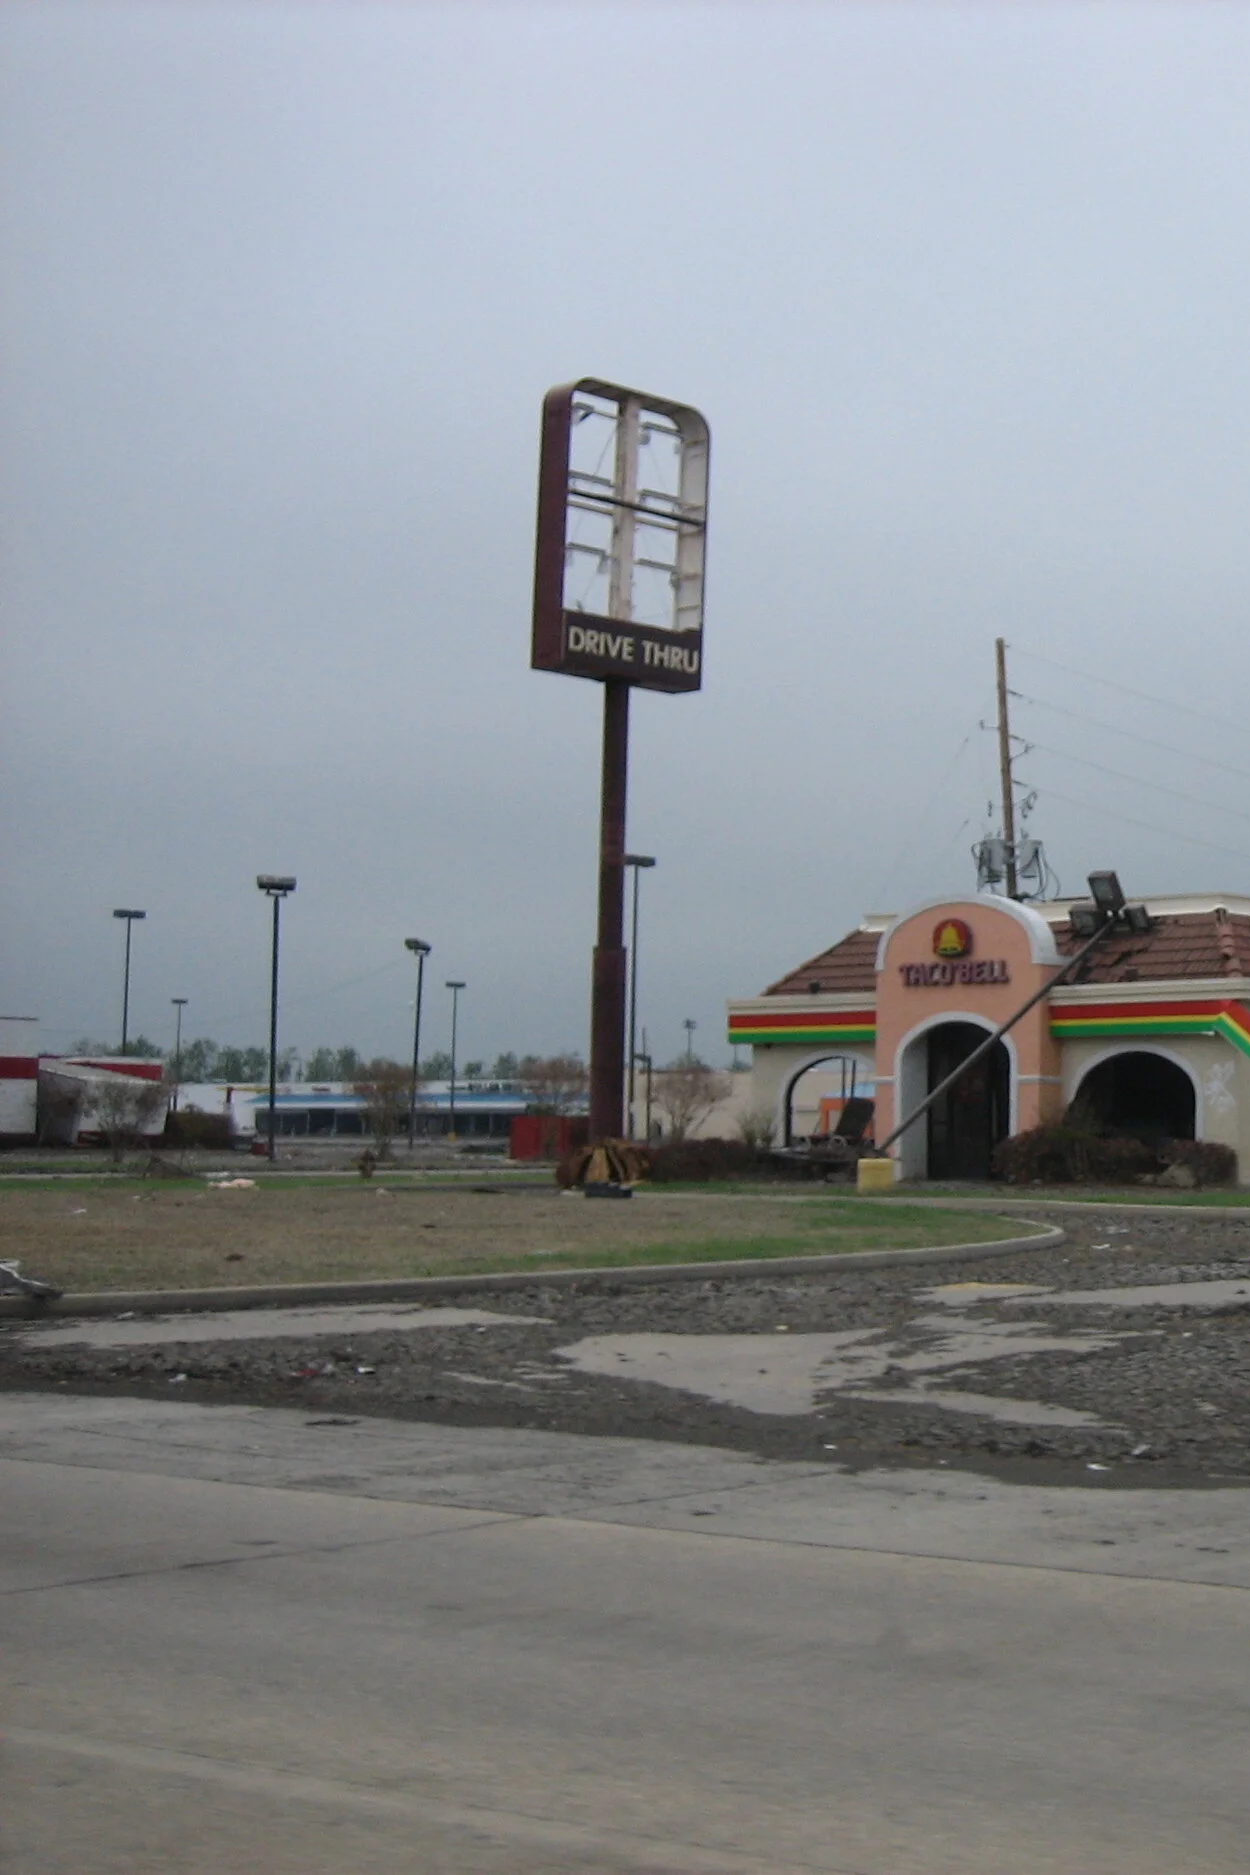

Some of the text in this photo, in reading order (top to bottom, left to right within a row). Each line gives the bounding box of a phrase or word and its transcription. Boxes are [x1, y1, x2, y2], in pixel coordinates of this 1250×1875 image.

[568, 626, 699, 674] DRIVE THRU
[899, 960, 1010, 987] TACO BELL
